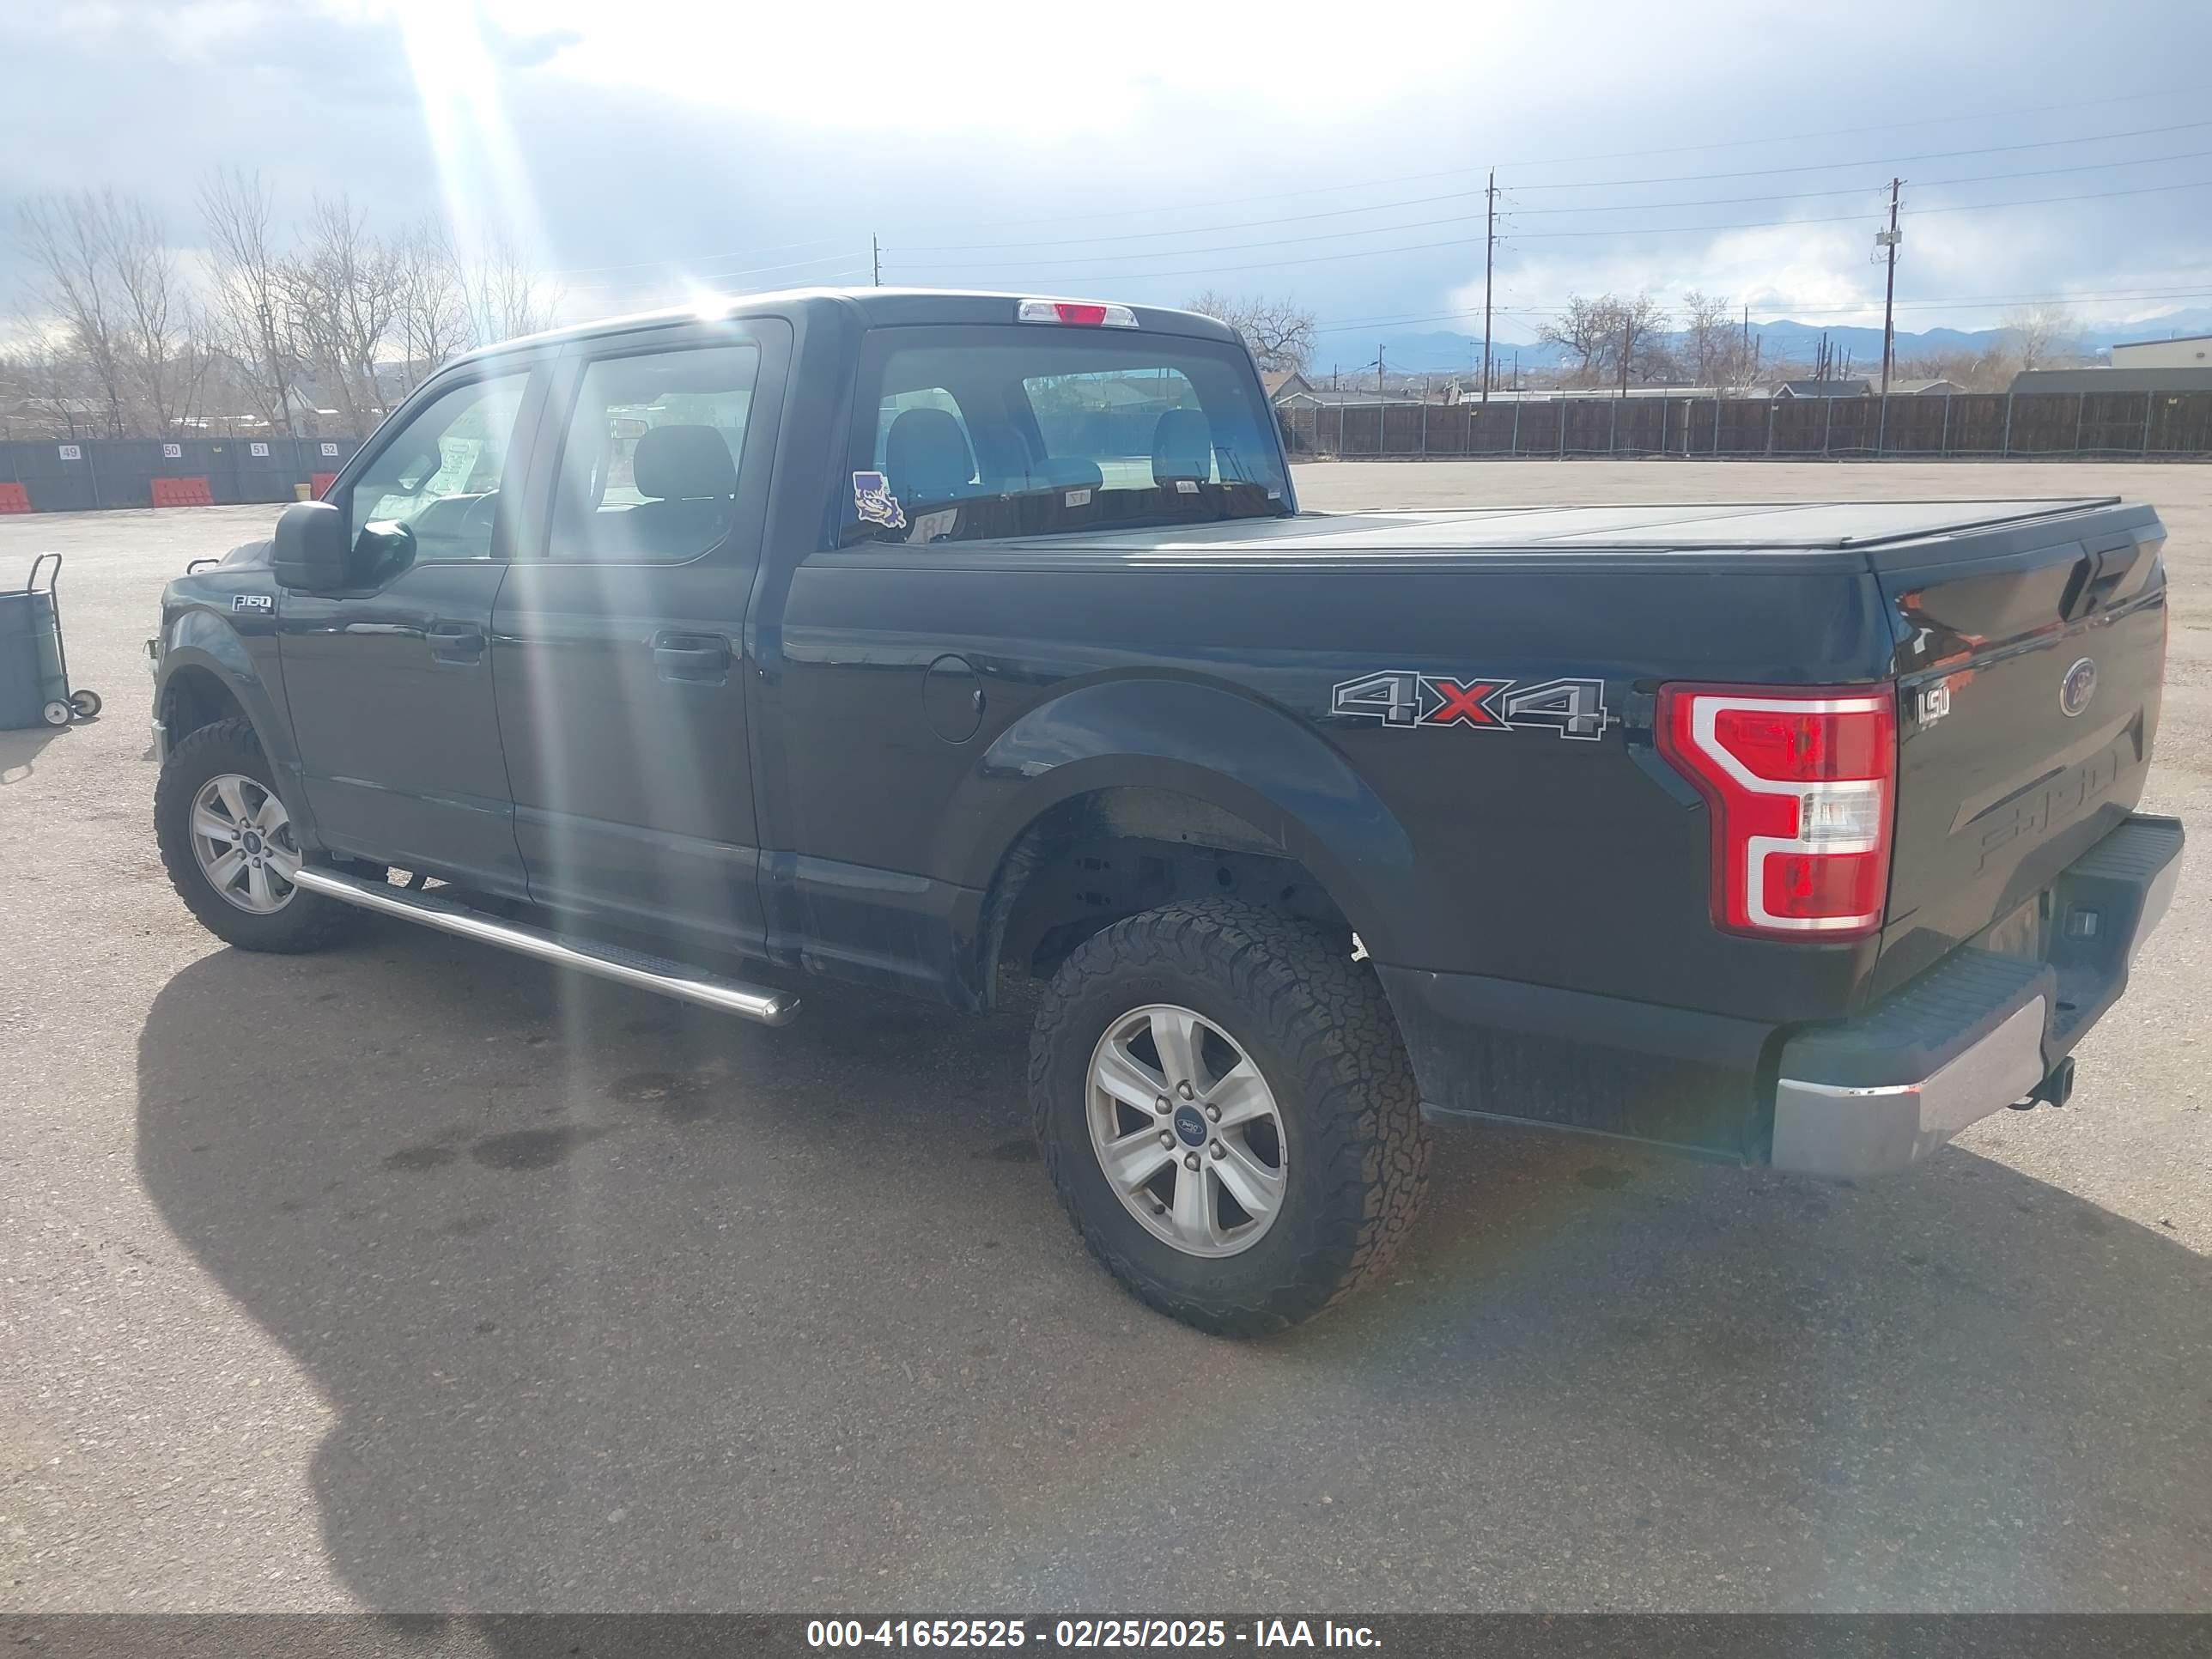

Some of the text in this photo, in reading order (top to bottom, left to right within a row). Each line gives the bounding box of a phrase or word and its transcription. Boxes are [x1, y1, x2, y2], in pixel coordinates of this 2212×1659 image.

[63, 447, 77, 458] 49
[164, 446, 178, 455] 50
[253, 445, 265, 454] 51
[324, 445, 336, 454] 52
